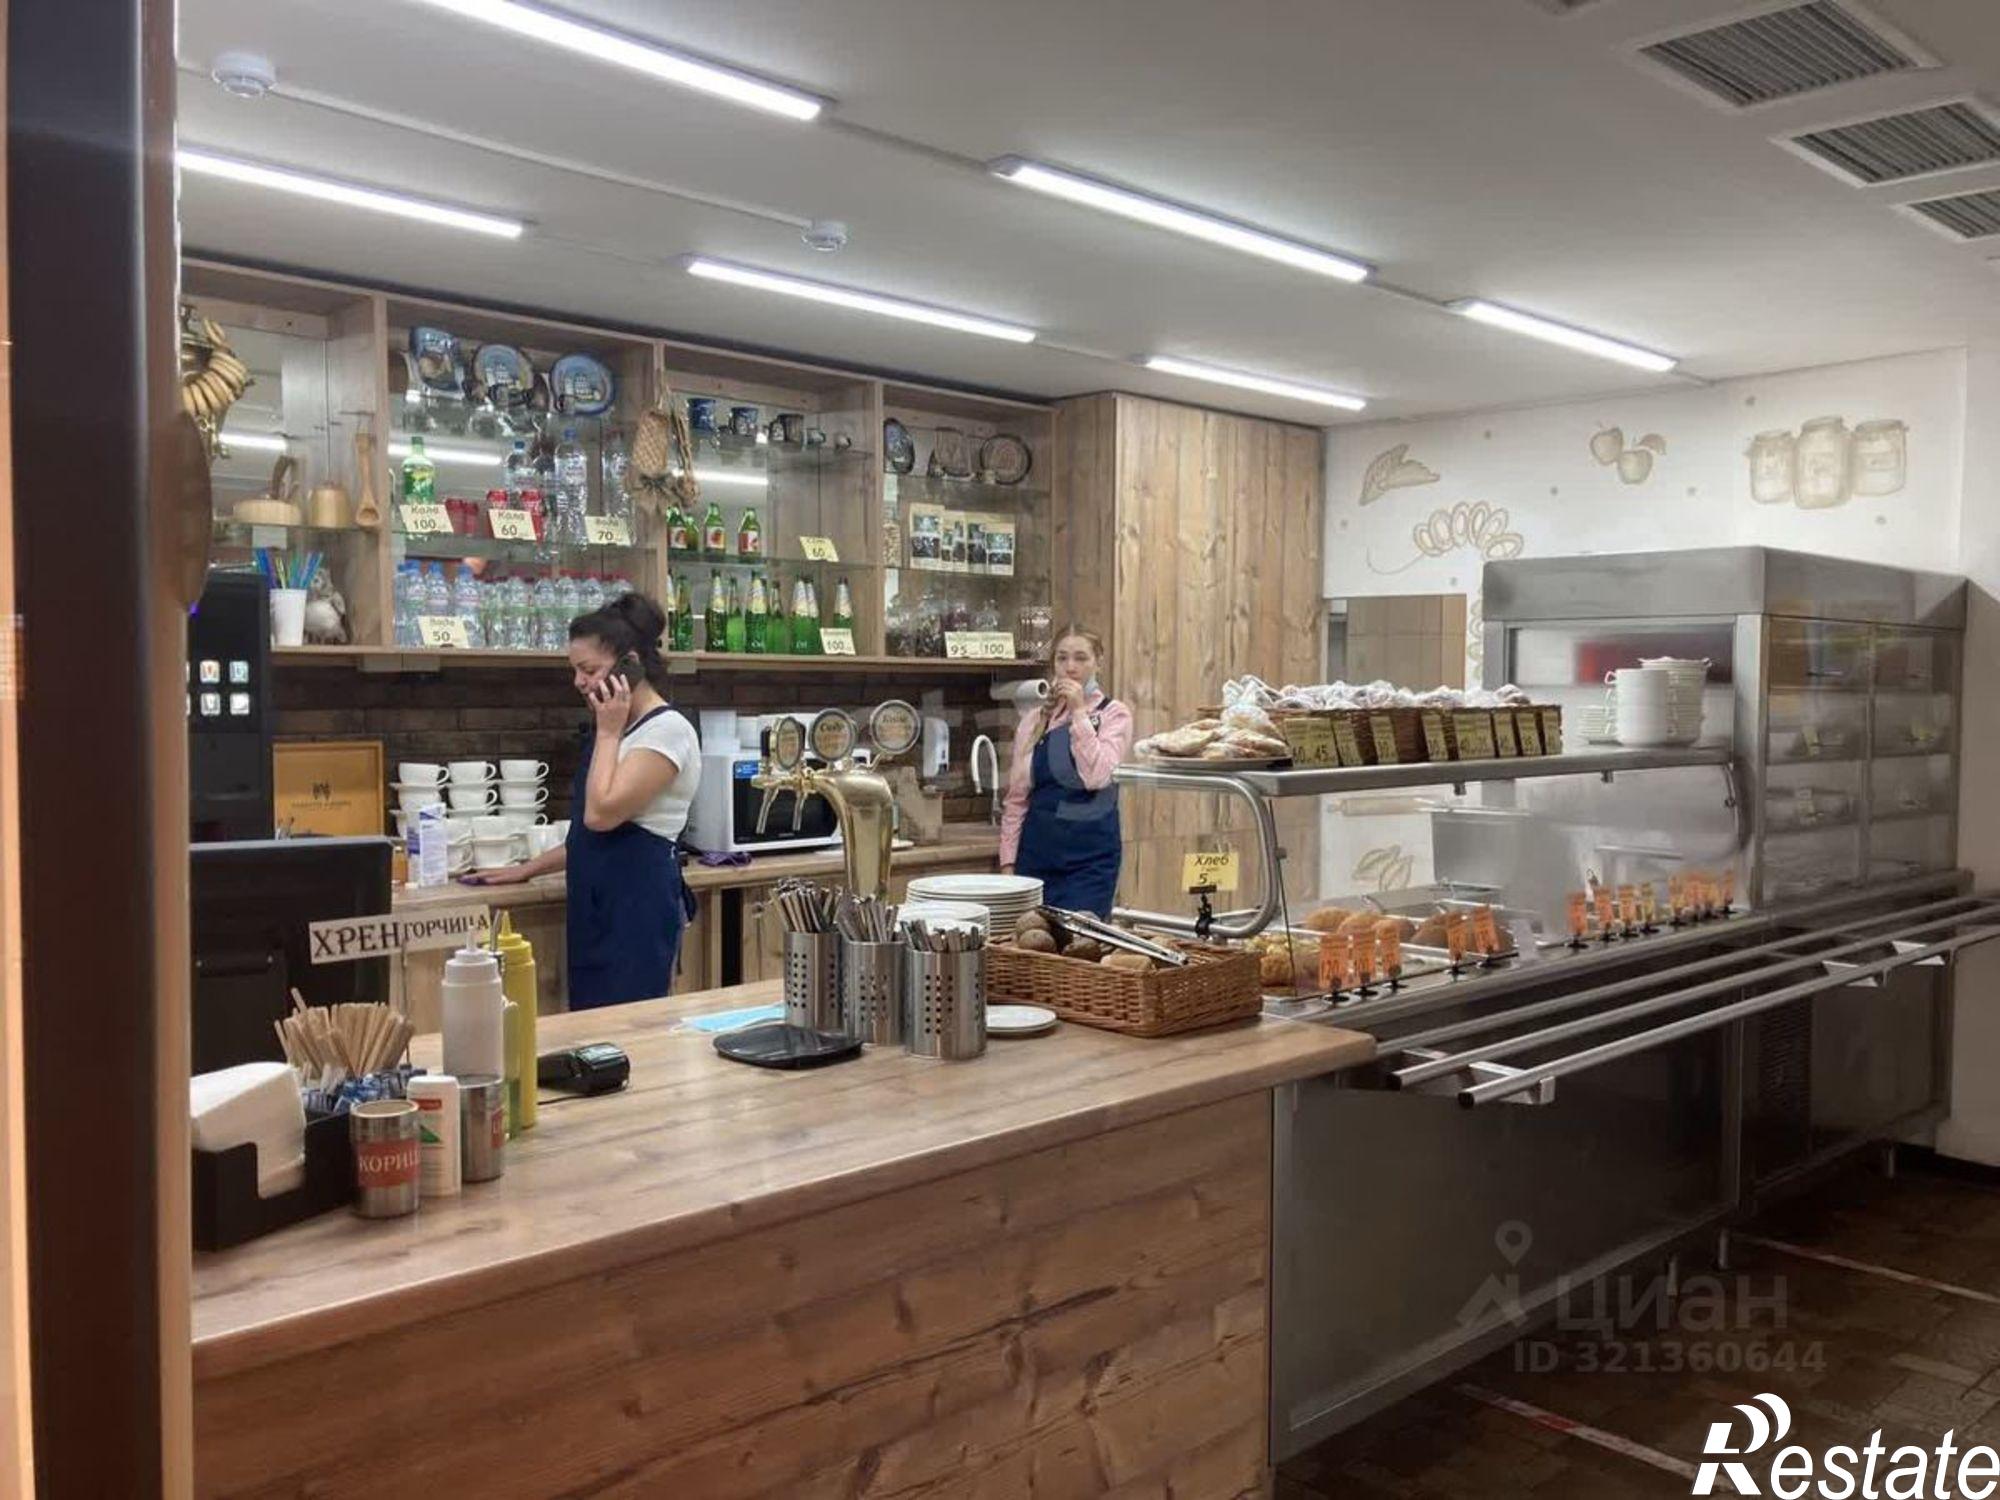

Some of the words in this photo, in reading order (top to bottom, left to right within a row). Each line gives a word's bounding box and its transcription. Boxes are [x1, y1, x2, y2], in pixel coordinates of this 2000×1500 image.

[413, 519, 436, 529] 100
[501, 524, 518, 536] 60
[597, 530, 614, 541] 70
[432, 631, 451, 642] 50
[827, 640, 845, 650] 100
[950, 644, 968, 656] 95
[984, 643, 1005, 655] 100
[1194, 852, 1230, 867] Хлеб
[1199, 872, 1209, 885] 5
[311, 921, 401, 959] ХРЕН
